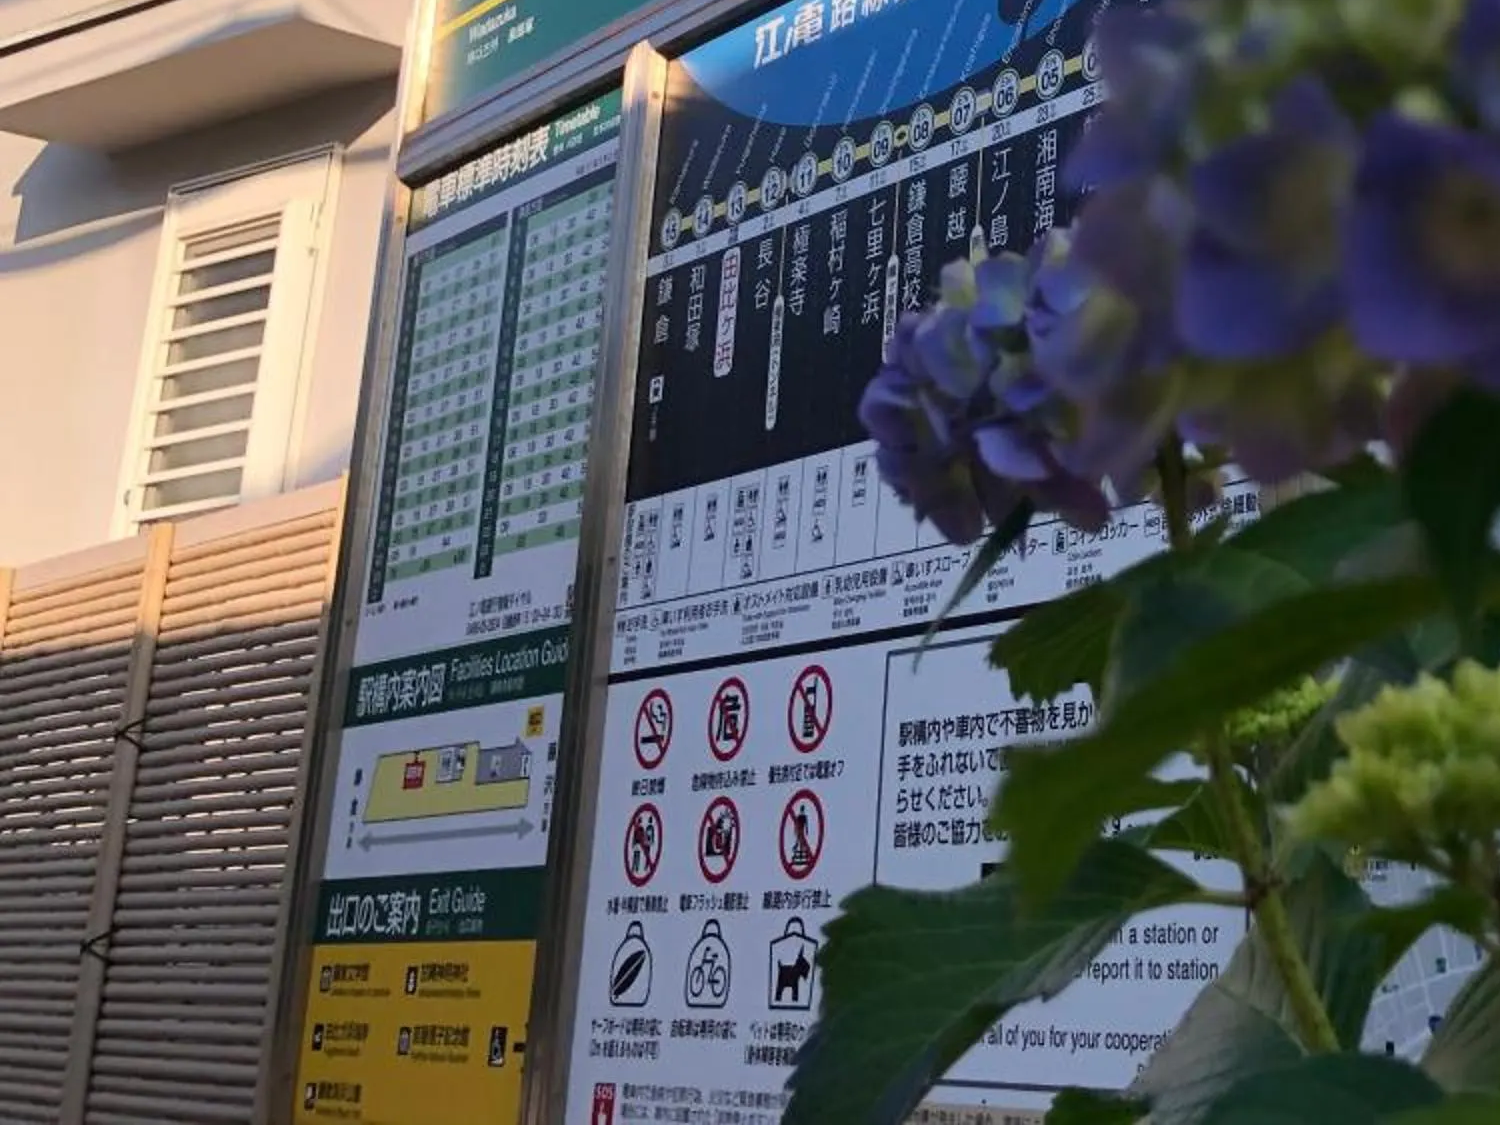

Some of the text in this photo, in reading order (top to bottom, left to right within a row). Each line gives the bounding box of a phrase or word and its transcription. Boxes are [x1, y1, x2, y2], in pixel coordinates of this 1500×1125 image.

[989, 147, 1012, 247] 江ノ島
[1034, 128, 1057, 241] 湘南海
[946, 162, 969, 243] 腰越
[753, 239, 773, 309] 長谷
[495, 644, 540, 676] Location
[897, 746, 1009, 781] 手をふれないで
[326, 889, 421, 936] 出口のご案内
[429, 885, 486, 914] Exit Guide
[1128, 928, 1138, 944] a
[1143, 922, 1197, 944] station
[1202, 926, 1219, 944] or
[1087, 958, 1219, 982] report it to station
[1005, 1025, 1019, 1046] of
[1022, 1029, 1046, 1052] you
[1049, 1027, 1067, 1047] for
[1071, 1031, 1102, 1054] your
